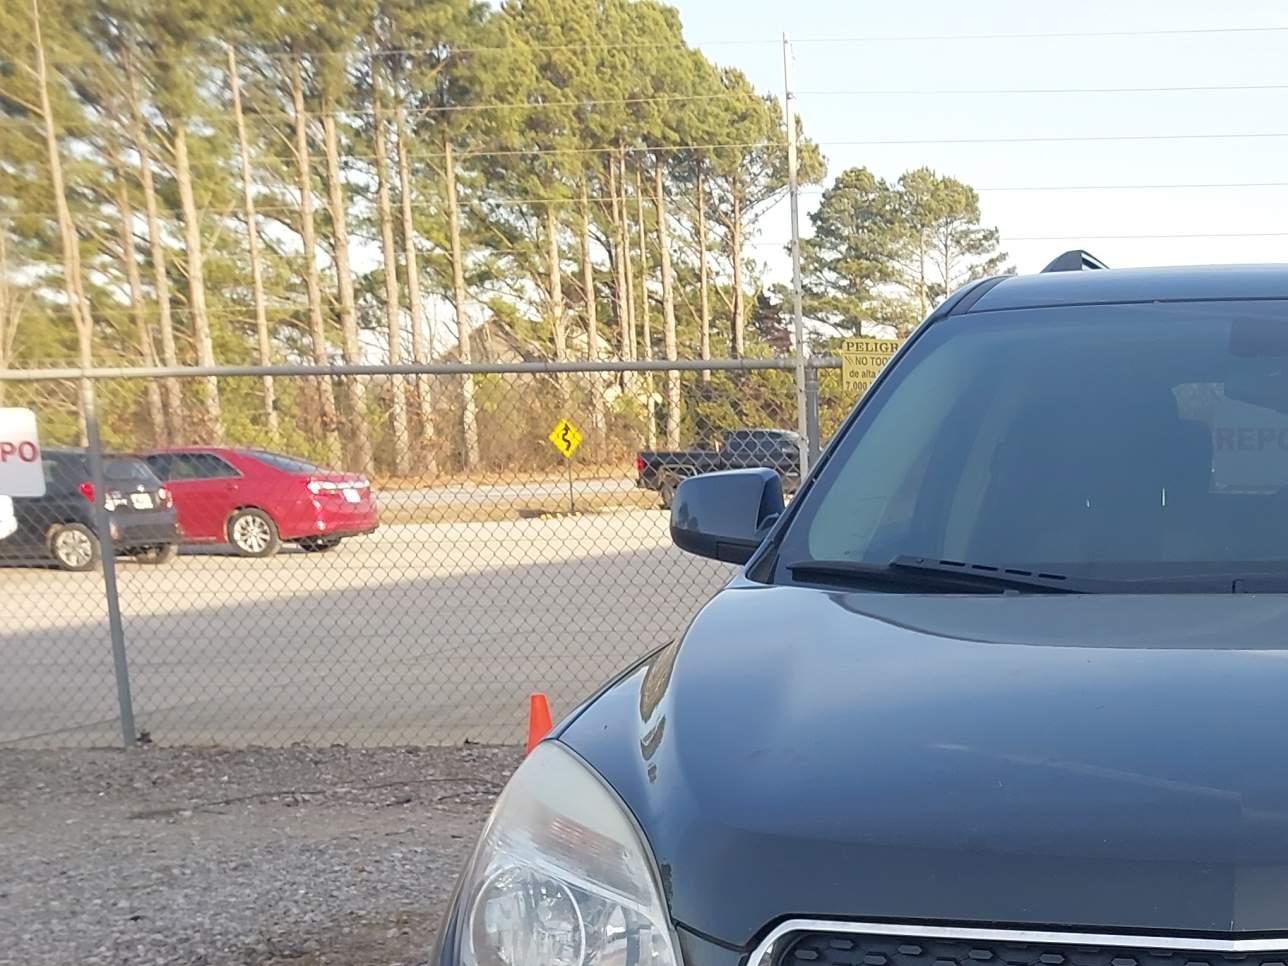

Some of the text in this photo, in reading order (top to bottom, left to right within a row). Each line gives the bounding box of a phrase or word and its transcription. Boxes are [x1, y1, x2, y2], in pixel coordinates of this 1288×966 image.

[846, 341, 899, 353] PELIGR
[855, 356, 868, 366] NO
[849, 369, 876, 378] de alta
